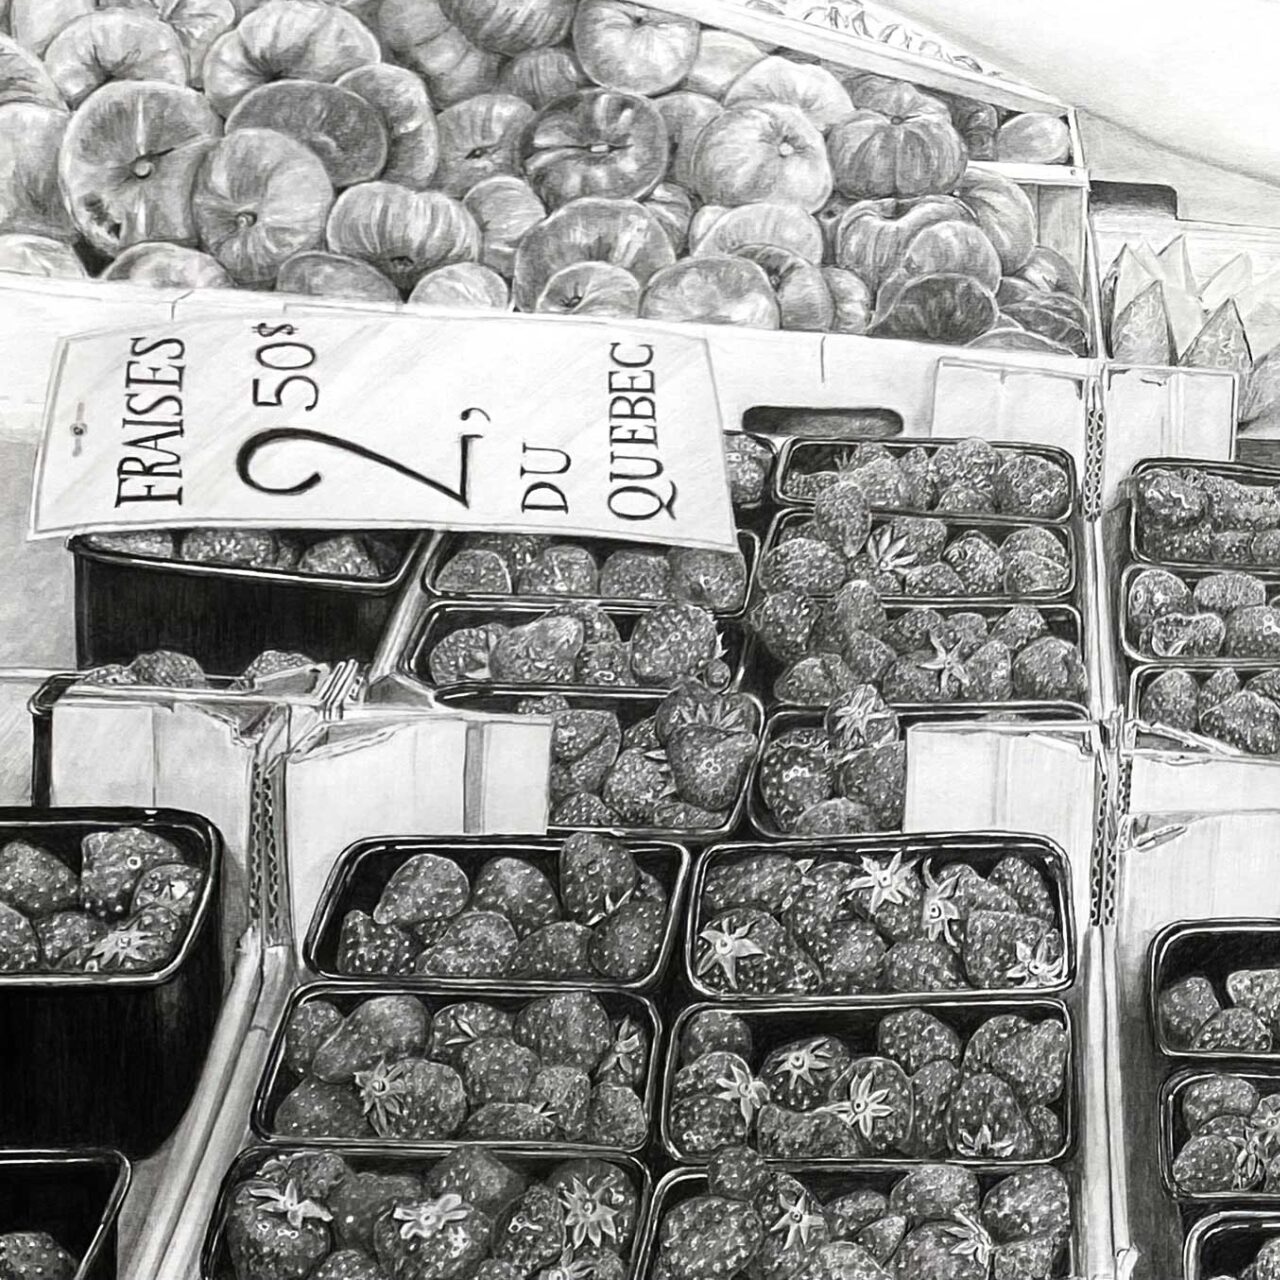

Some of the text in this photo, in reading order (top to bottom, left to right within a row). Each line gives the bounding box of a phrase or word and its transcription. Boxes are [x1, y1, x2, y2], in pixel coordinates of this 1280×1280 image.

[114, 336, 185, 508] FRAISES
[519, 442, 571, 514] DU
[607, 342, 676, 520] QUEBEC
